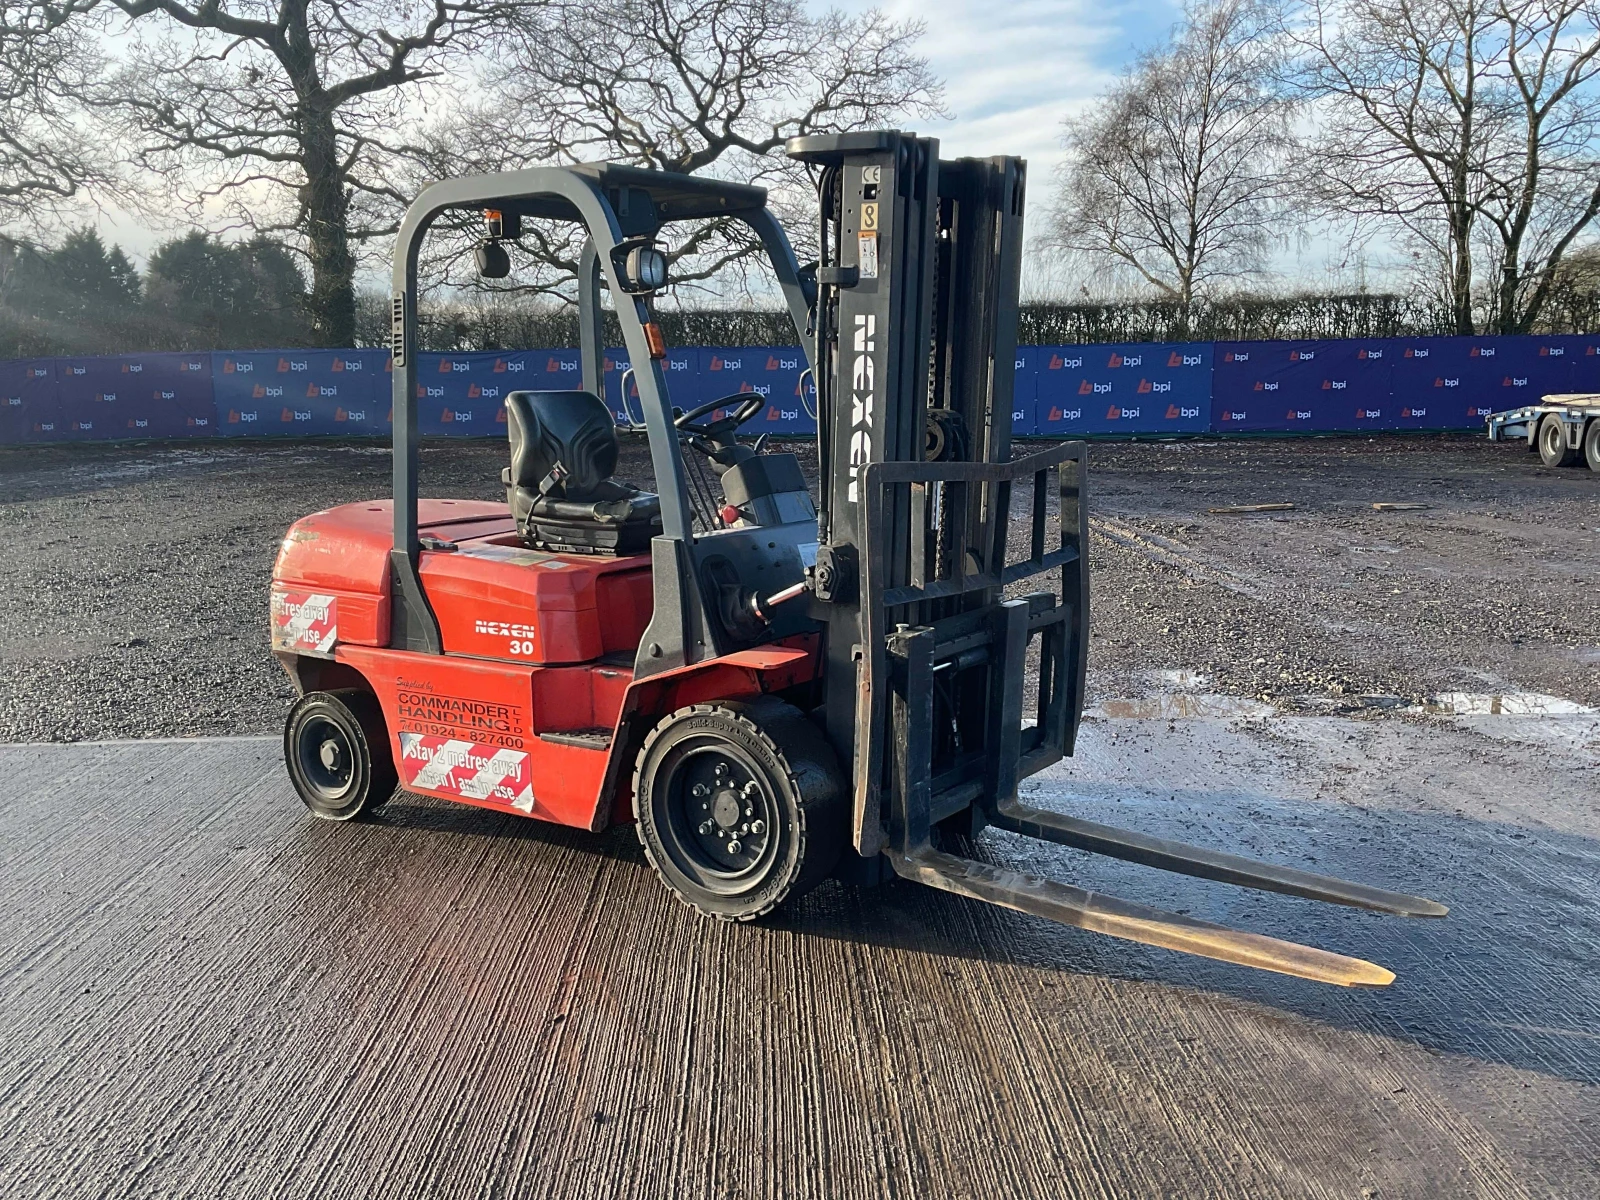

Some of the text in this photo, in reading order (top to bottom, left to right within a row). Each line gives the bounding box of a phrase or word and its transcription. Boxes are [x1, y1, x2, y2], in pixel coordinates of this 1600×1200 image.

[1300, 352, 1314, 360] bpi
[1369, 350, 1382, 359] bpi
[1415, 349, 1428, 357] bpi
[1481, 348, 1494, 357] bpi
[1550, 347, 1564, 356] bpi
[1124, 355, 1141, 367] bpi
[1184, 355, 1201, 366] bpi
[1235, 353, 1248, 361] bpi
[189, 362, 201, 370] bpi
[237, 362, 253, 373] bpi
[291, 361, 307, 371] bpi
[346, 361, 362, 371] bpi
[453, 362, 469, 372] bpi
[508, 361, 524, 372] bpi
[561, 361, 577, 371] bpi
[671, 360, 687, 371] bpi
[725, 359, 741, 370] bpi
[780, 359, 797, 370] bpi
[1014, 358, 1025, 370] pi
[1065, 357, 1081, 368] bpi
[35, 368, 47, 376] bpi
[74, 367, 85, 375] bpi
[130, 364, 142, 372] bpi
[1153, 381, 1171, 393] bpi
[1265, 382, 1278, 390] bpi
[1333, 381, 1346, 389] bpi
[1445, 378, 1458, 387] bpi
[1513, 378, 1527, 386] bpi
[266, 386, 282, 397] bpi
[321, 386, 336, 396] bpi
[427, 387, 443, 397] bpi
[482, 386, 498, 397] bpi
[1094, 382, 1111, 394] bpi
[104, 393, 116, 401] bpi
[162, 391, 174, 399] bpi
[9, 397, 21, 405] bpi
[241, 411, 257, 422] bpi
[295, 411, 311, 421] bpi
[349, 411, 365, 421] bpi
[455, 411, 471, 422] bpi
[617, 411, 629, 421] bp
[781, 409, 797, 420] bpi
[1012, 409, 1024, 421] pi
[1064, 408, 1080, 420] bpi
[1122, 407, 1139, 419] bpi
[1181, 407, 1199, 418] bpi
[1232, 412, 1245, 420] bpi
[1298, 411, 1311, 419] bpi
[1367, 409, 1380, 418] bpi
[1412, 408, 1425, 417] bpi
[1478, 408, 1492, 417] bpi
[1478, 408, 1501, 424] bpi
[80, 422, 92, 430] bpi
[136, 419, 147, 427] bpi
[196, 418, 207, 426] bpi
[304, 604, 329, 625] away
[476, 620, 535, 639] NEXEN
[509, 640, 534, 655] 30
[397, 676, 433, 692] Supplied by
[398, 693, 509, 719] COMMANDER
[398, 705, 510, 732] HANDLING
[414, 722, 447, 738] 01924
[470, 731, 523, 748] 827400
[409, 739, 522, 783] Stay 2 metres away
[418, 766, 448, 787] when
[449, 771, 456, 788] I
[493, 784, 520, 801] use.
[639, 778, 657, 845] ADVANCE
